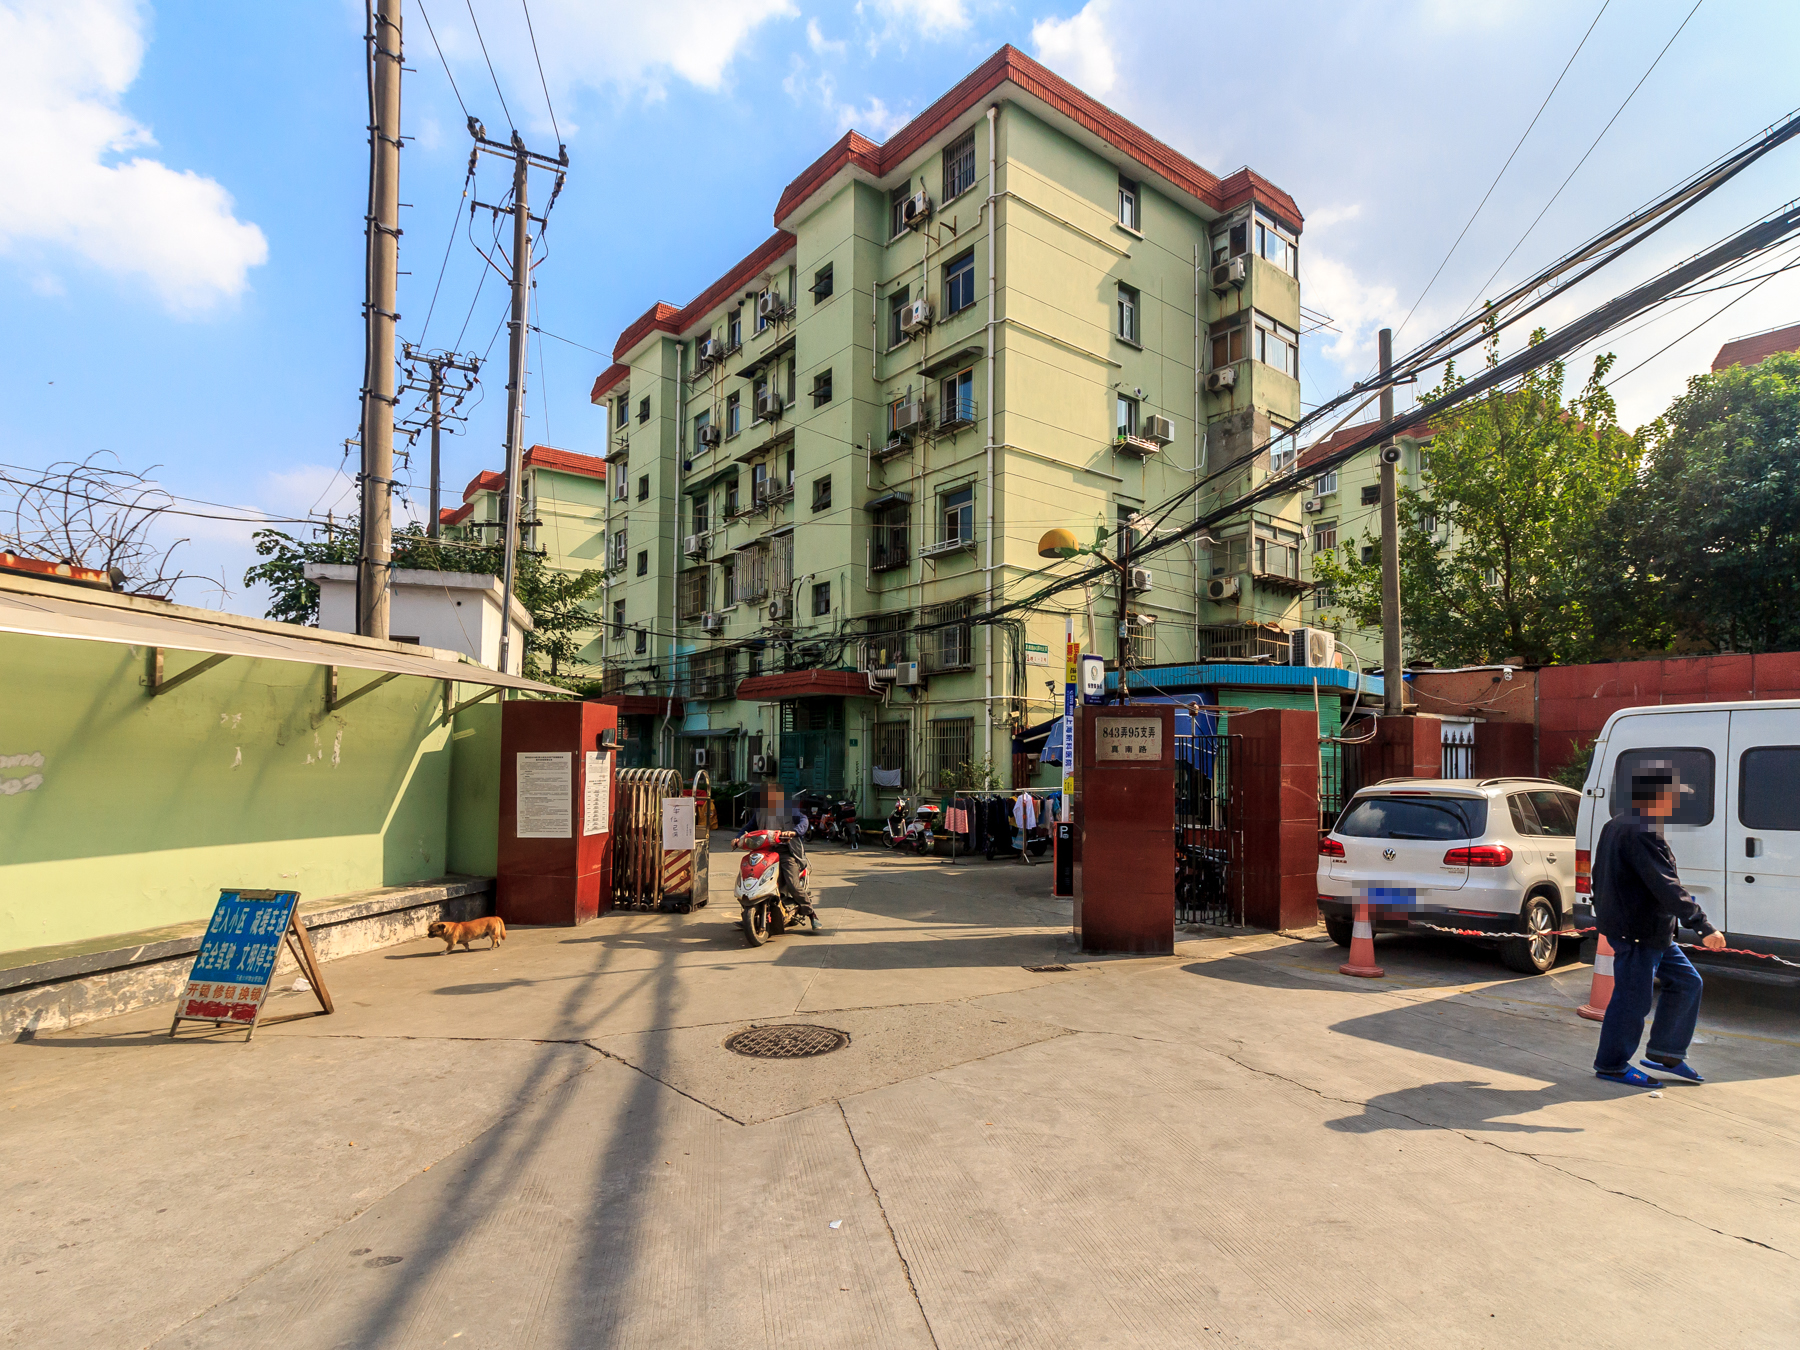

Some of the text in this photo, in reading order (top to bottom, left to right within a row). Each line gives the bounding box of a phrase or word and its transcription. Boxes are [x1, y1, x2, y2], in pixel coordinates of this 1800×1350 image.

[1102, 726, 1156, 738] 843弄95支弄
[1111, 745, 1147, 753] 真南路
[210, 905, 289, 936] 进入小区 减缓车速
[197, 940, 277, 973] 安全驾驶 文明停车
[186, 983, 264, 1001] 开锁 修锁 换锁
